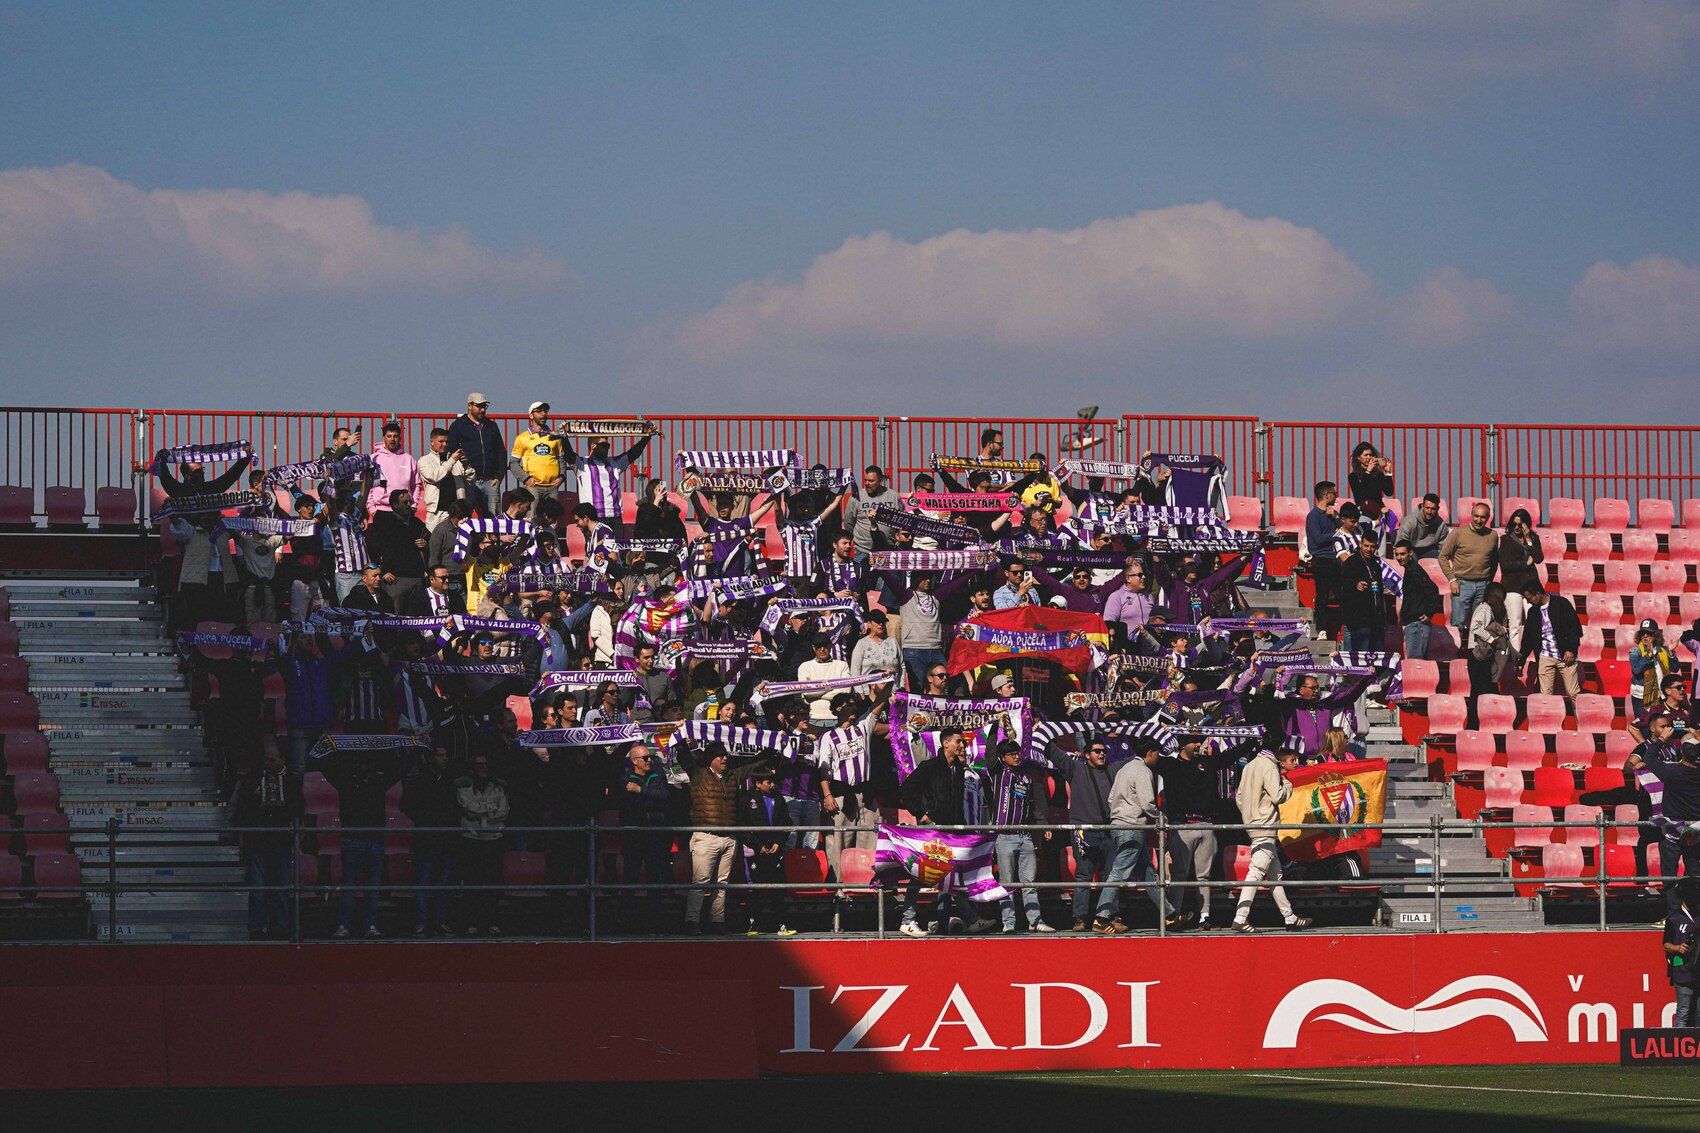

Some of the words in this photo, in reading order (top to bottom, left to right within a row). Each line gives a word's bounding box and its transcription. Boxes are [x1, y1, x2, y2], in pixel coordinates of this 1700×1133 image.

[570, 421, 592, 434] REAL
[593, 421, 643, 434] VALLADOLID
[712, 455, 770, 464] PUCELA
[1168, 455, 1199, 463] PUCELA
[699, 476, 766, 488] VALLADOLI
[193, 490, 250, 508] VALLADOLID
[924, 498, 1002, 509] VALLISOLETANA
[286, 519, 309, 534] REAL
[890, 514, 912, 527] REAL
[917, 521, 965, 537] VALLADOLID
[889, 552, 902, 569] SI
[908, 552, 924, 569] SE
[928, 552, 971, 569] PUEDE
[1076, 556, 1112, 564] Valladolid
[778, 598, 799, 609] REAL
[800, 598, 852, 607] VALLADOLID
[401, 618, 435, 626] PODRÁN
[463, 619, 486, 628] REAL
[487, 620, 541, 630] VALLADOLID
[194, 634, 217, 642] AUPA
[220, 635, 252, 646] PUCELA
[991, 634, 1013, 645] AUPA
[1016, 635, 1046, 646] PUCELA
[451, 664, 505, 674] VALLADOLID
[551, 673, 579, 683] Real
[91, 697, 127, 708] Emsac
[1084, 690, 1160, 704] VALLADOLID
[908, 698, 939, 710] REAL
[945, 701, 1022, 711] VALLADOLID
[118, 773, 155, 784] Emsac
[127, 813, 164, 825] Emsac
[1402, 914, 1420, 922] FILA
[779, 980, 1162, 1053] IZADI
